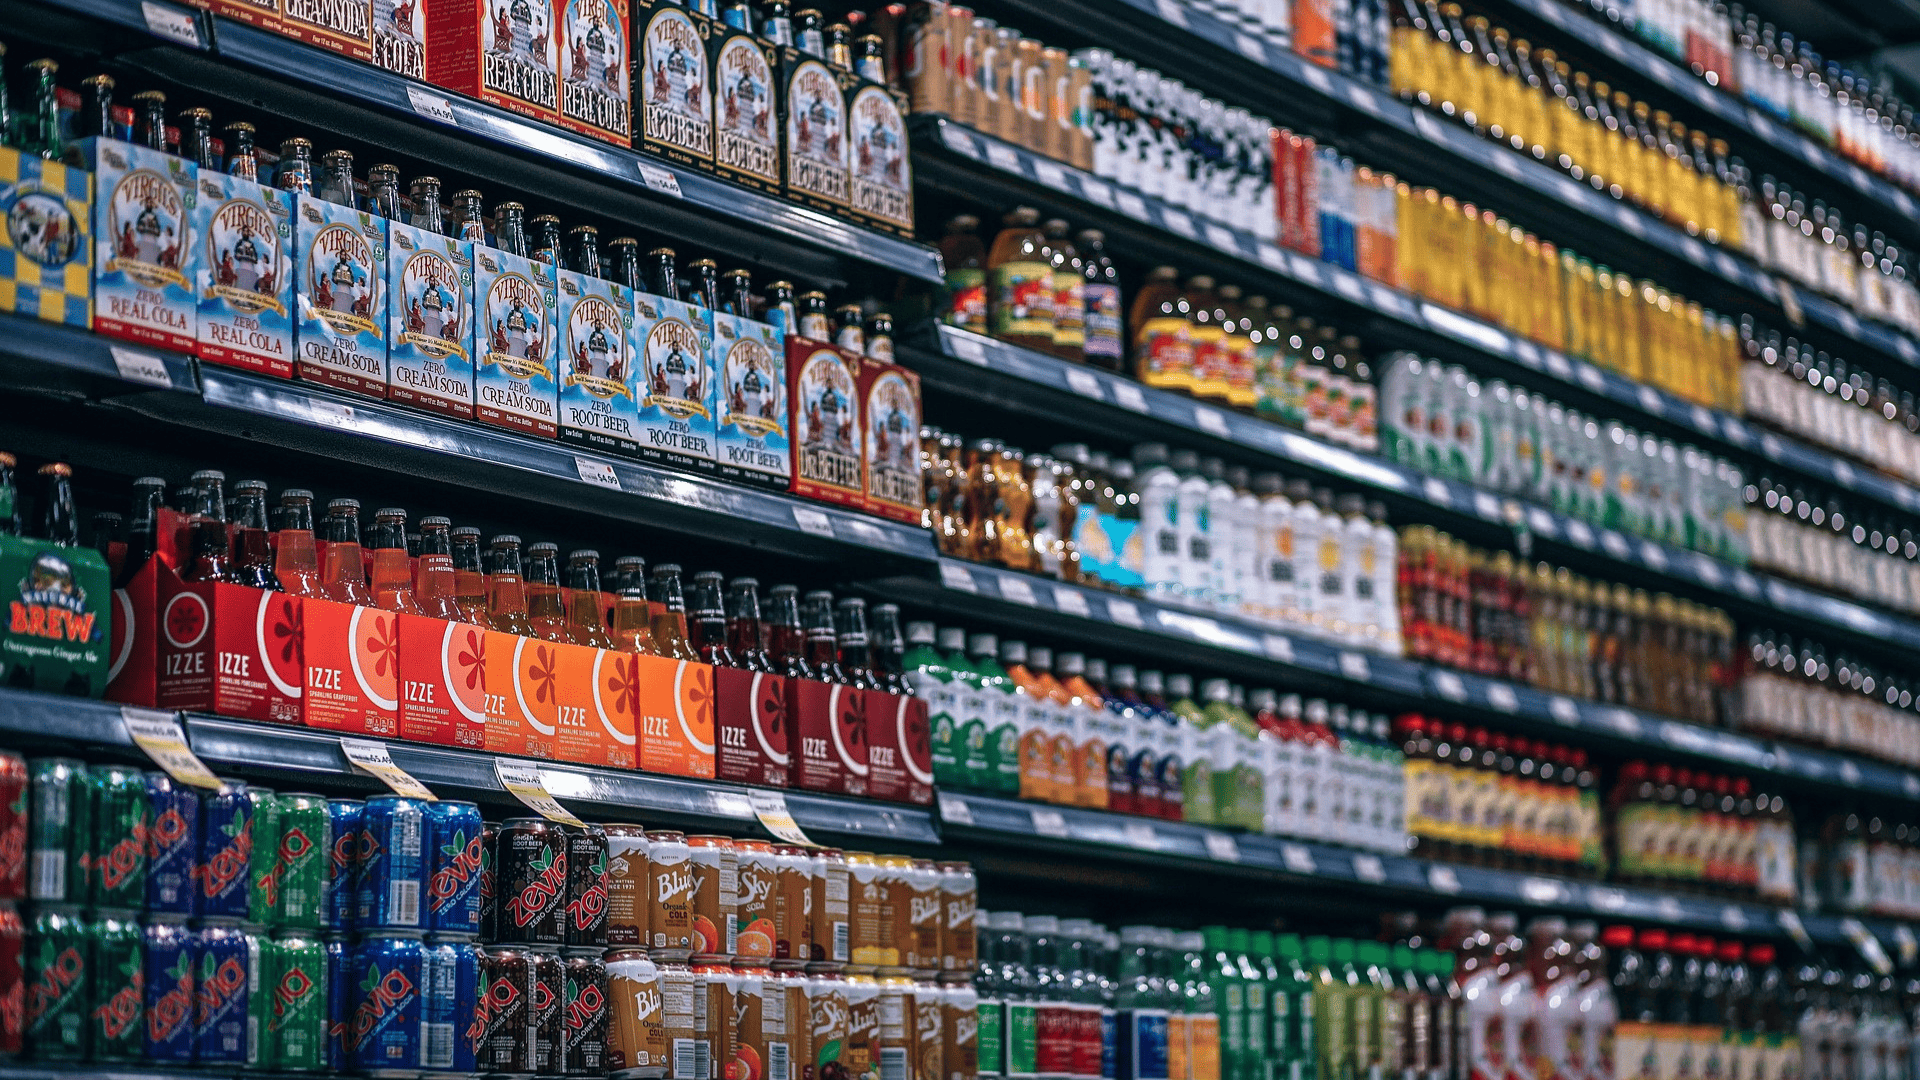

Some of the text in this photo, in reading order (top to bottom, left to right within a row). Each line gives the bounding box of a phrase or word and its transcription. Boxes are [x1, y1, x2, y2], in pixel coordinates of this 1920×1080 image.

[484, 52, 557, 109] REAL COLA
[431, 106, 453, 120] $4.99
[563, 80, 628, 133] REAL COLA
[219, 205, 272, 245] VIRGIL'S
[320, 229, 368, 268] VIRGIL'S
[410, 256, 455, 292] VIRGIL'S
[495, 278, 539, 314] VIRGIL'S
[152, 305, 187, 330] COLA
[233, 315, 258, 331] ZERO
[576, 300, 619, 335] VIRGIL'S
[208, 322, 247, 345] REAL
[250, 333, 282, 354] COLA
[334, 336, 357, 352] ZERO
[653, 323, 697, 356] VIRGIL'S
[306, 342, 381, 376] CREAM SODA
[423, 360, 445, 375] ZERO
[396, 366, 468, 398] CREAM SODA
[508, 380, 530, 395] ZERO
[482, 386, 552, 417] CREAM SODA
[591, 400, 611, 414] ZERO
[570, 407, 632, 437] ROOT BEER
[669, 420, 690, 434] ZERO
[647, 428, 710, 456] ROOT BEER
[598, 472, 617, 485] $4.99
[10, 601, 94, 643] BREW
[52, 648, 81, 663] Ginger
[167, 652, 205, 675] IZZE
[219, 652, 249, 677] IZZE
[308, 666, 342, 690] IZZE
[309, 690, 358, 703] SPARKLING GRAPEFRUIT
[404, 681, 434, 704] IZZE
[405, 704, 426, 713] SPARKLING
[485, 694, 506, 716] ZZE
[558, 705, 586, 727] IZZE
[643, 716, 669, 738] IZZE
[721, 726, 747, 748] IZZE
[803, 737, 828, 759] IZZE
[657, 870, 691, 902] Blue
[746, 902, 765, 911] SODA
[528, 911, 546, 929] ZERO
[504, 1000, 521, 1018] SODA
[542, 1004, 556, 1021] SODA
[635, 988, 661, 1020] Blu
[571, 1021, 595, 1046] CALORIE
